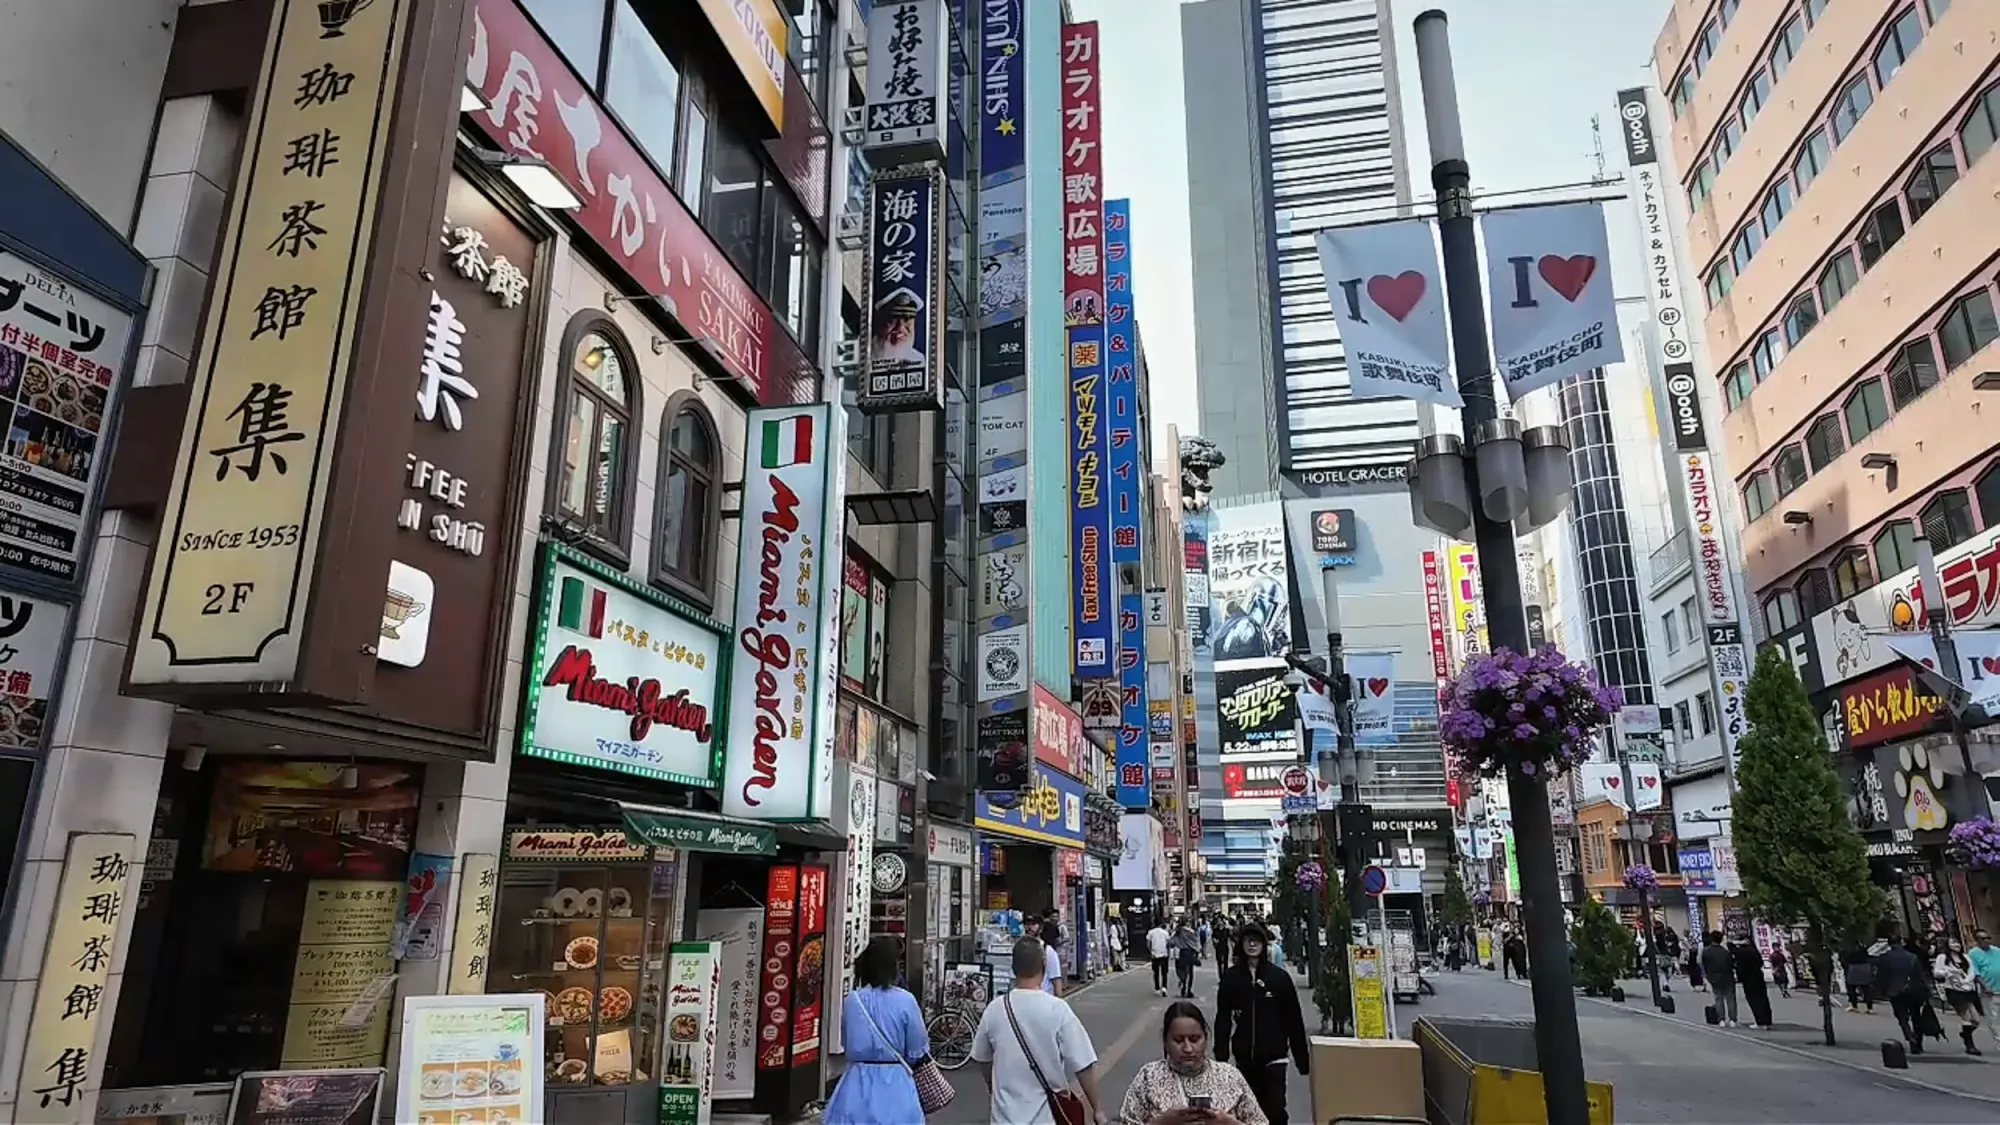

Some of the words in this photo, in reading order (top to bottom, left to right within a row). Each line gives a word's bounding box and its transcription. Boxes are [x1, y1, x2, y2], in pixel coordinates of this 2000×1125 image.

[871, 100, 933, 130] 大阪家
[1065, 34, 1098, 277] カラオケ歌広場
[982, 206, 1023, 217] Penelope
[1639, 171, 1662, 233] ネットカフェ
[881, 189, 920, 284] 海の家
[25, 272, 76, 307] DELTA
[703, 251, 764, 335] YAKINIKU
[1338, 278, 1369, 324] I
[1507, 256, 1539, 308] I
[699, 290, 762, 381] SAKAI
[1507, 321, 1604, 367] KABUKI-CHO
[1360, 361, 1443, 393] 歌舞伎町
[1508, 332, 1604, 383] 歌舞伎町
[982, 422, 1003, 431] TOM
[1005, 420, 1025, 429] CAT
[1667, 374, 1699, 437] Booth
[1073, 375, 1099, 508] マツモトキヨシ
[406, 452, 468, 508] FEE
[1302, 470, 1346, 485] HOTEL
[1348, 466, 1408, 481] GRACER
[1688, 466, 1713, 523] カラオケ
[180, 528, 243, 553] SINCE
[248, 523, 301, 550] 1953
[757, 473, 800, 628] Miami
[1211, 540, 1284, 566] 新宿に
[1211, 561, 1286, 582] 帰ってくる
[201, 582, 254, 615] 2F
[1712, 627, 1737, 645] 2F
[543, 645, 639, 717] Miami
[630, 679, 713, 744] Garden
[1120, 610, 1145, 788] カラオケ館
[1219, 680, 1291, 717] マンダロリアン
[1238, 699, 1286, 731] グローグー
[740, 626, 792, 806] Garden
[596, 737, 664, 763] マイアミガーデン
[517, 834, 576, 850] Miami
[1390, 820, 1439, 831] CINEMAS
[664, 1094, 694, 1104] OPEN
